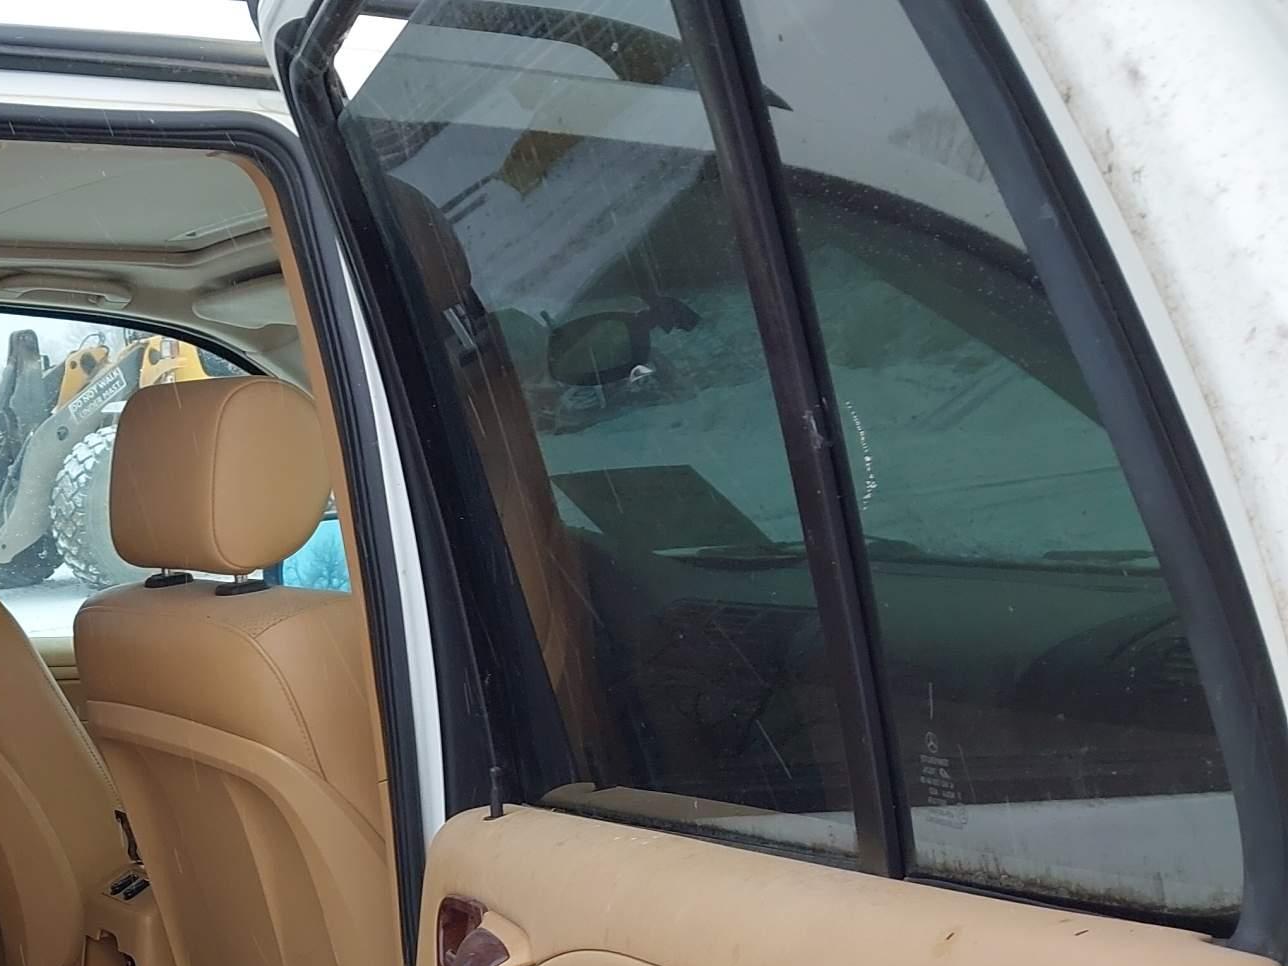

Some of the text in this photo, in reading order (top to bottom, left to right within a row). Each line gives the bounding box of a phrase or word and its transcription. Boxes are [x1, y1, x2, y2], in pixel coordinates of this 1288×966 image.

[72, 368, 120, 411] DO NOT WALK
